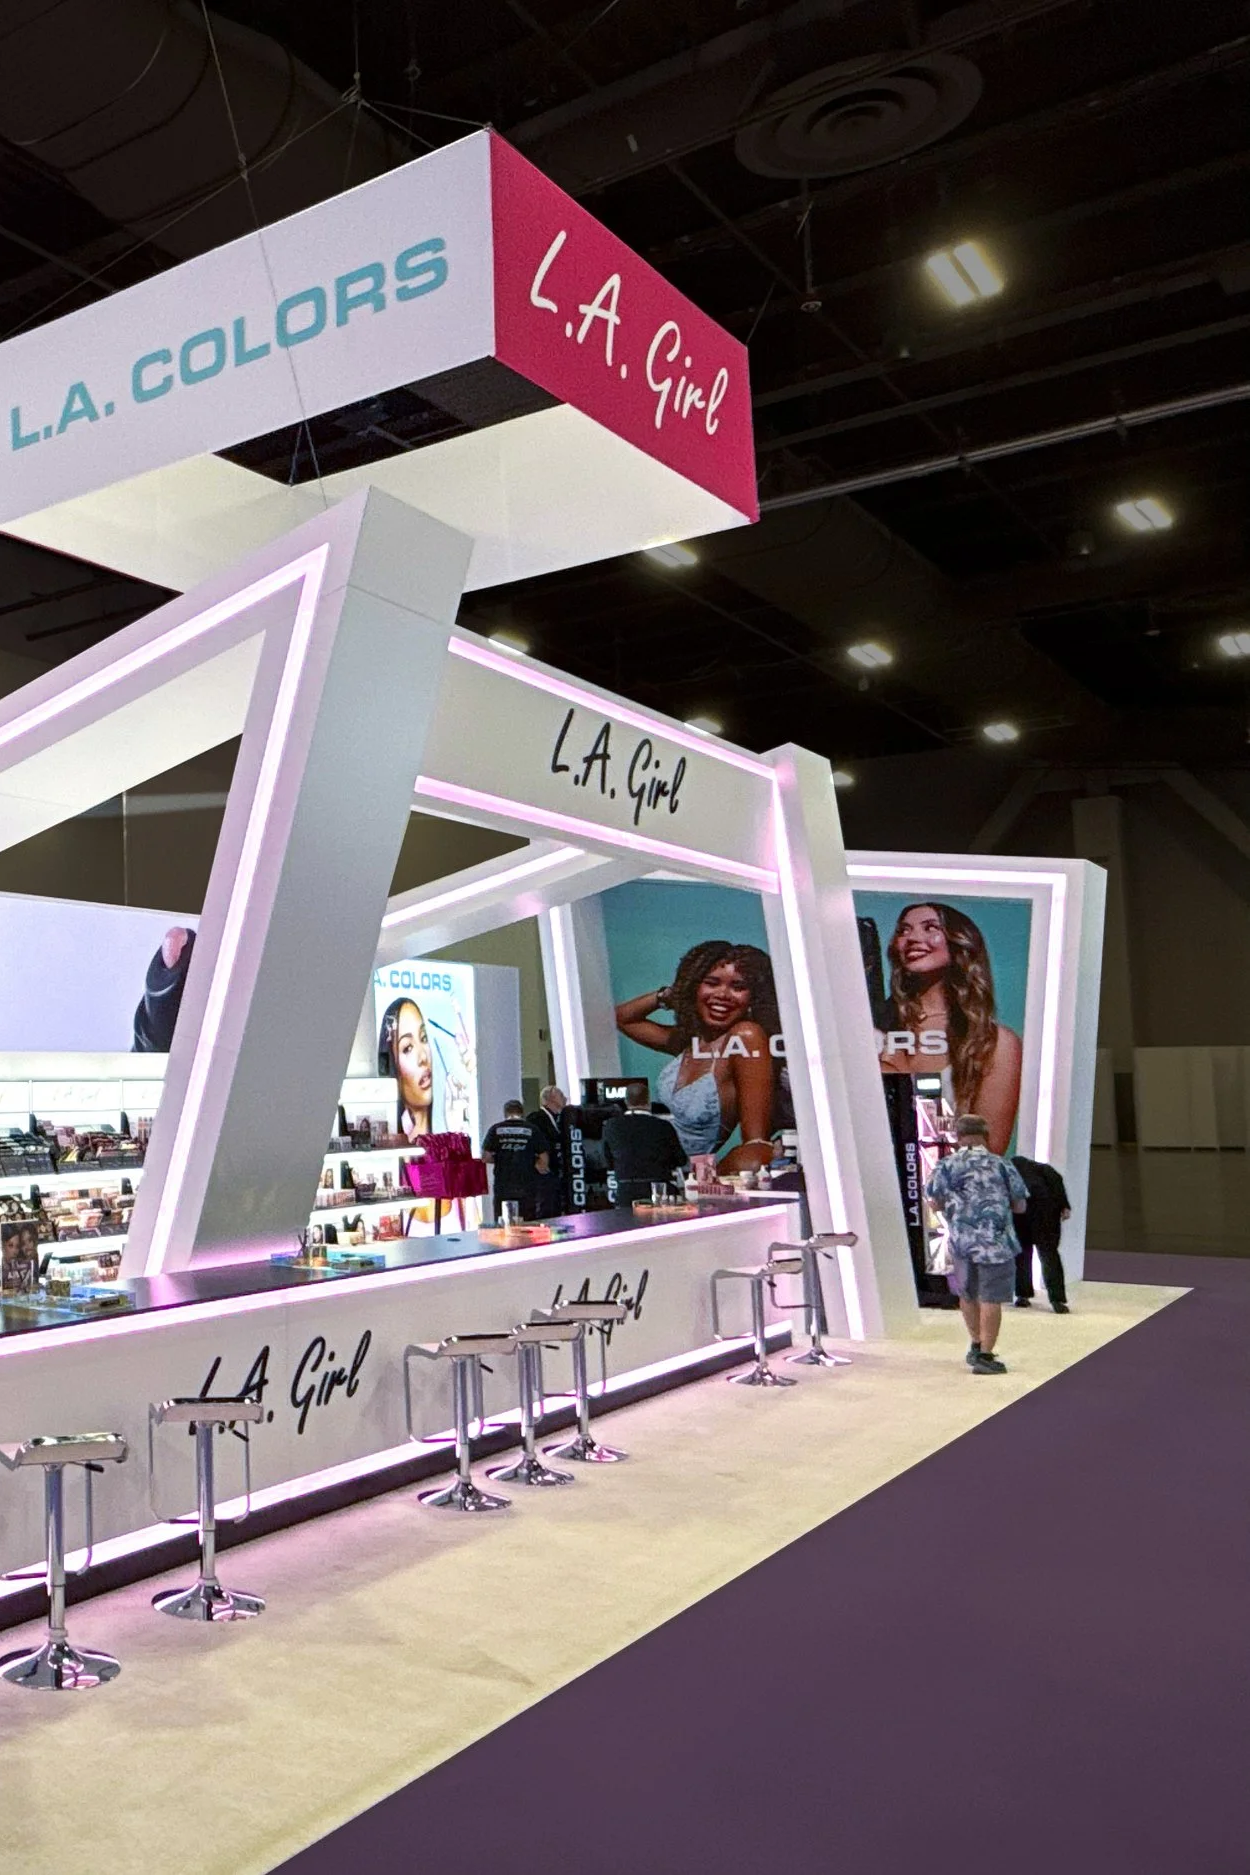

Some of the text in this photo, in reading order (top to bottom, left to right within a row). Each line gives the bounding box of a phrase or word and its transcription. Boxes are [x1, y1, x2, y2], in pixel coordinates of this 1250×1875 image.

[11, 237, 449, 451] L.A. COLORS
[530, 230, 728, 435] L.A. Girl
[551, 708, 686, 825] L.A. Girl
[390, 970, 452, 991] COLORS
[692, 1036, 759, 1059] L.A.
[570, 1128, 586, 1206] COLORS
[905, 1143, 920, 1227] L.A. COLORS
[290, 1329, 372, 1434] Girl
